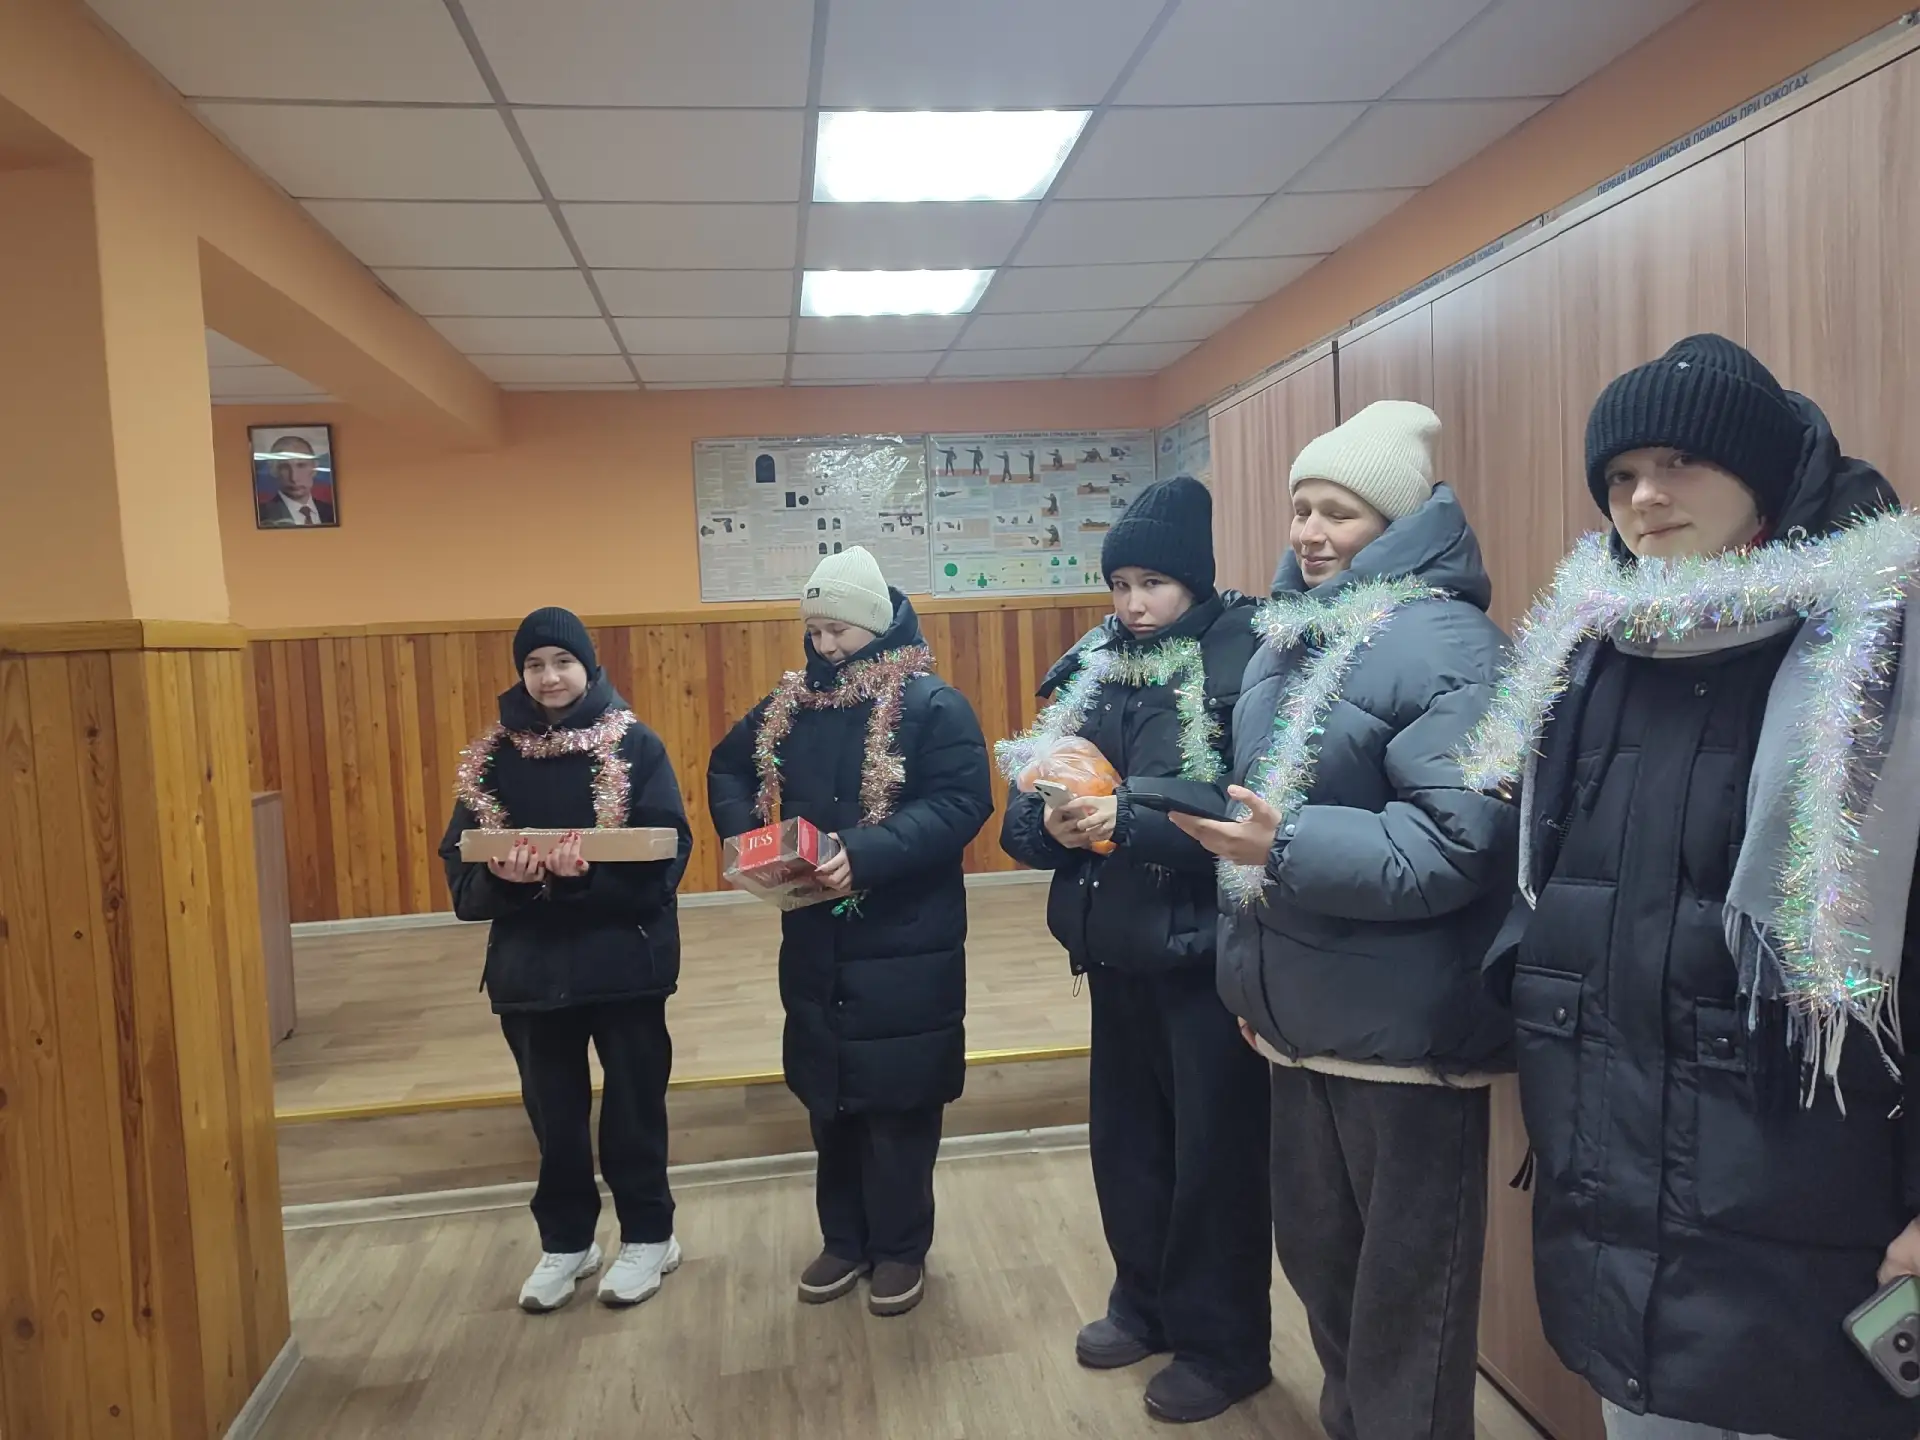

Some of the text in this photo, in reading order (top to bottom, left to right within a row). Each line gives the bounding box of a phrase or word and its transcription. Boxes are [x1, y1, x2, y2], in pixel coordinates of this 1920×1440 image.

[1597, 74, 1809, 196] ПЕРВАЯ МЕДИЦИНСКАЯ ПОМОЩЬ ПРИ ОЖОГАХ
[748, 831, 773, 851] TESS
